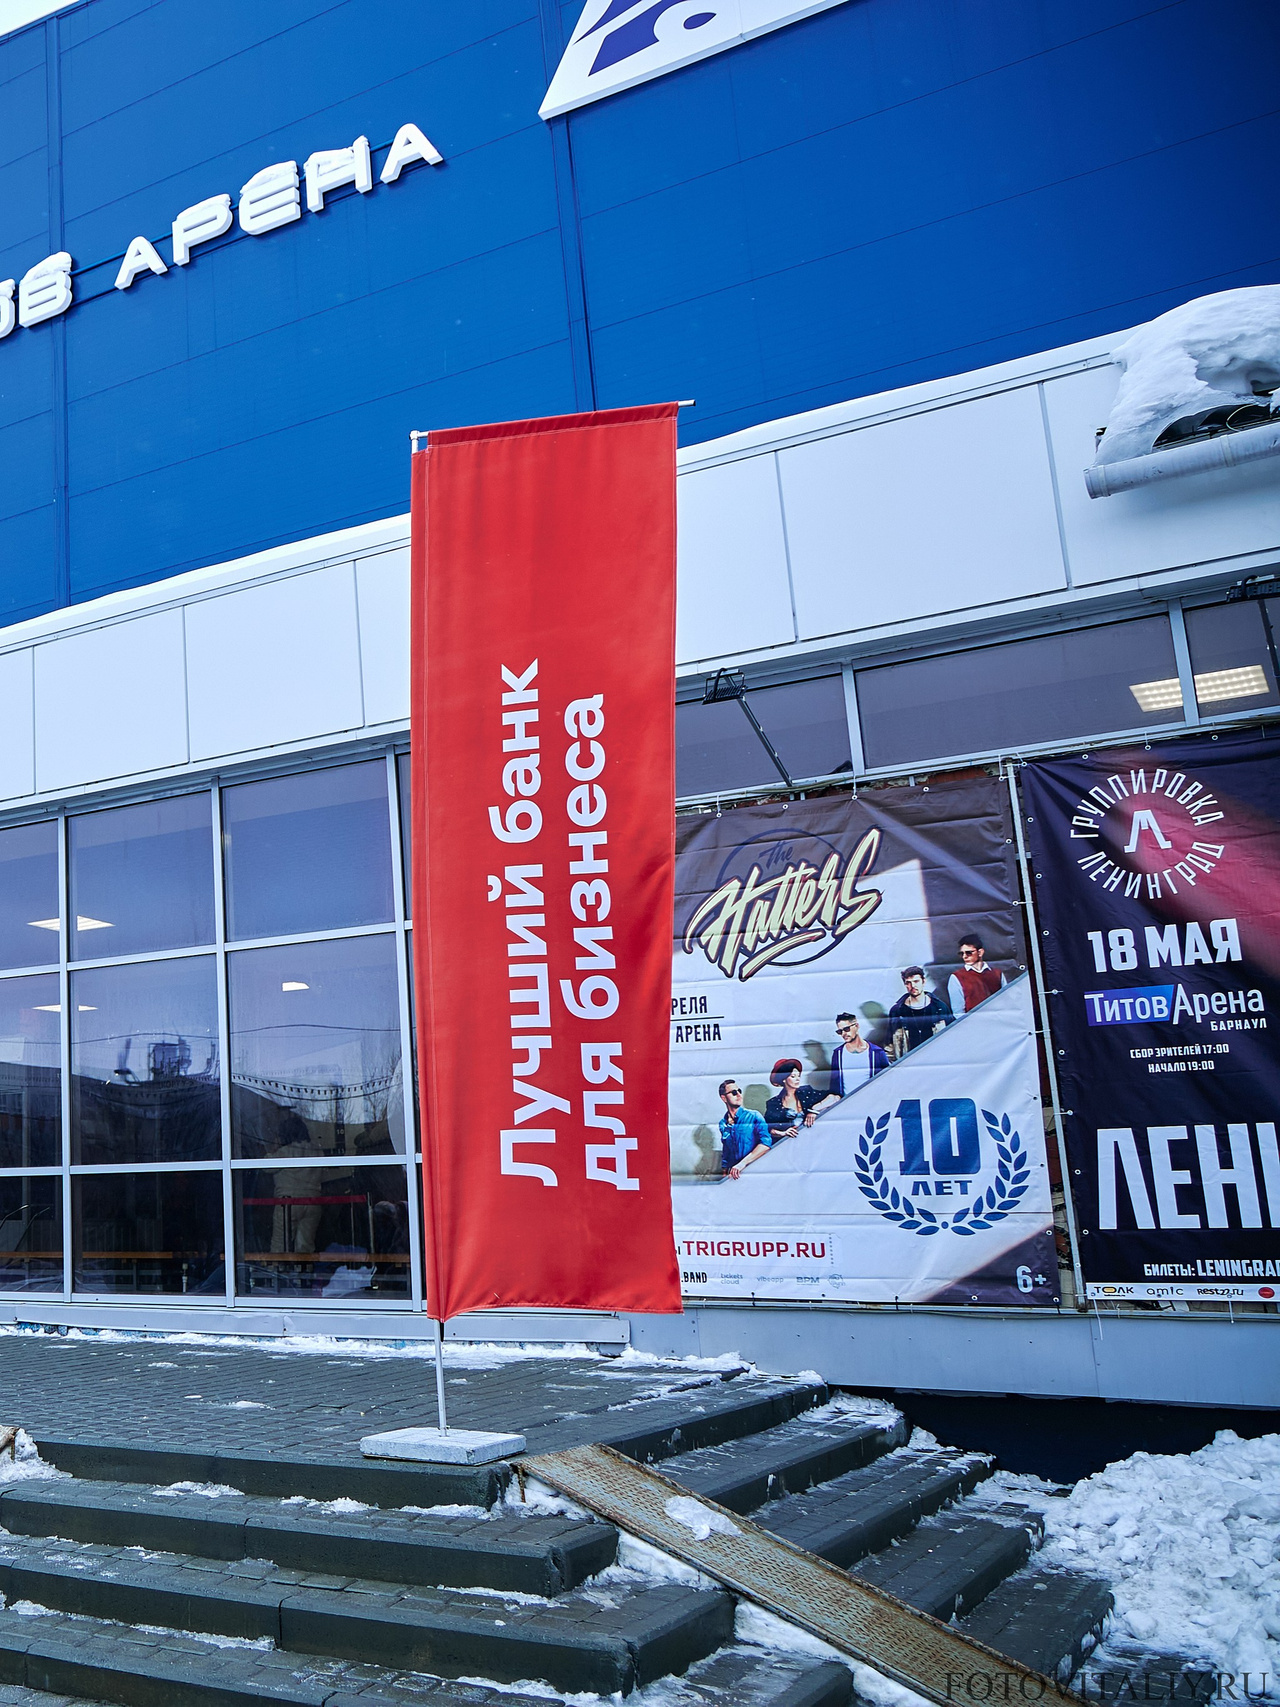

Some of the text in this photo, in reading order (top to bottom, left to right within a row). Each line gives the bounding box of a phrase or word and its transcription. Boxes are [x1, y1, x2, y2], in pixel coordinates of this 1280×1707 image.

[114, 122, 444, 291] АРЕНА
[1070, 768, 1225, 839] ГРУППИРОВКА
[1076, 841, 1226, 900] ЛЕНИНГРАД
[488, 657, 571, 1187] Лучший банк
[559, 692, 640, 1191] для бизнеса
[1087, 918, 1243, 973] 18 МАЯ
[675, 1023, 722, 1043] АРЕНА
[1210, 1017, 1268, 1032] БАРНАУЛ
[1129, 1043, 1230, 1059] СБОР ЗРИТЕЛЕЙ 17:00
[1148, 1060, 1216, 1073] НАЧАЛО 19:00
[894, 1097, 982, 1176] 10
[911, 1179, 973, 1196] ЛЕТ
[682, 1240, 827, 1259] TRIGRUPP.RU
[1016, 1265, 1047, 1293] 6+
[1144, 1263, 1196, 1277] БИЛЕТЫ:
[1146, 1286, 1184, 1296] amic
